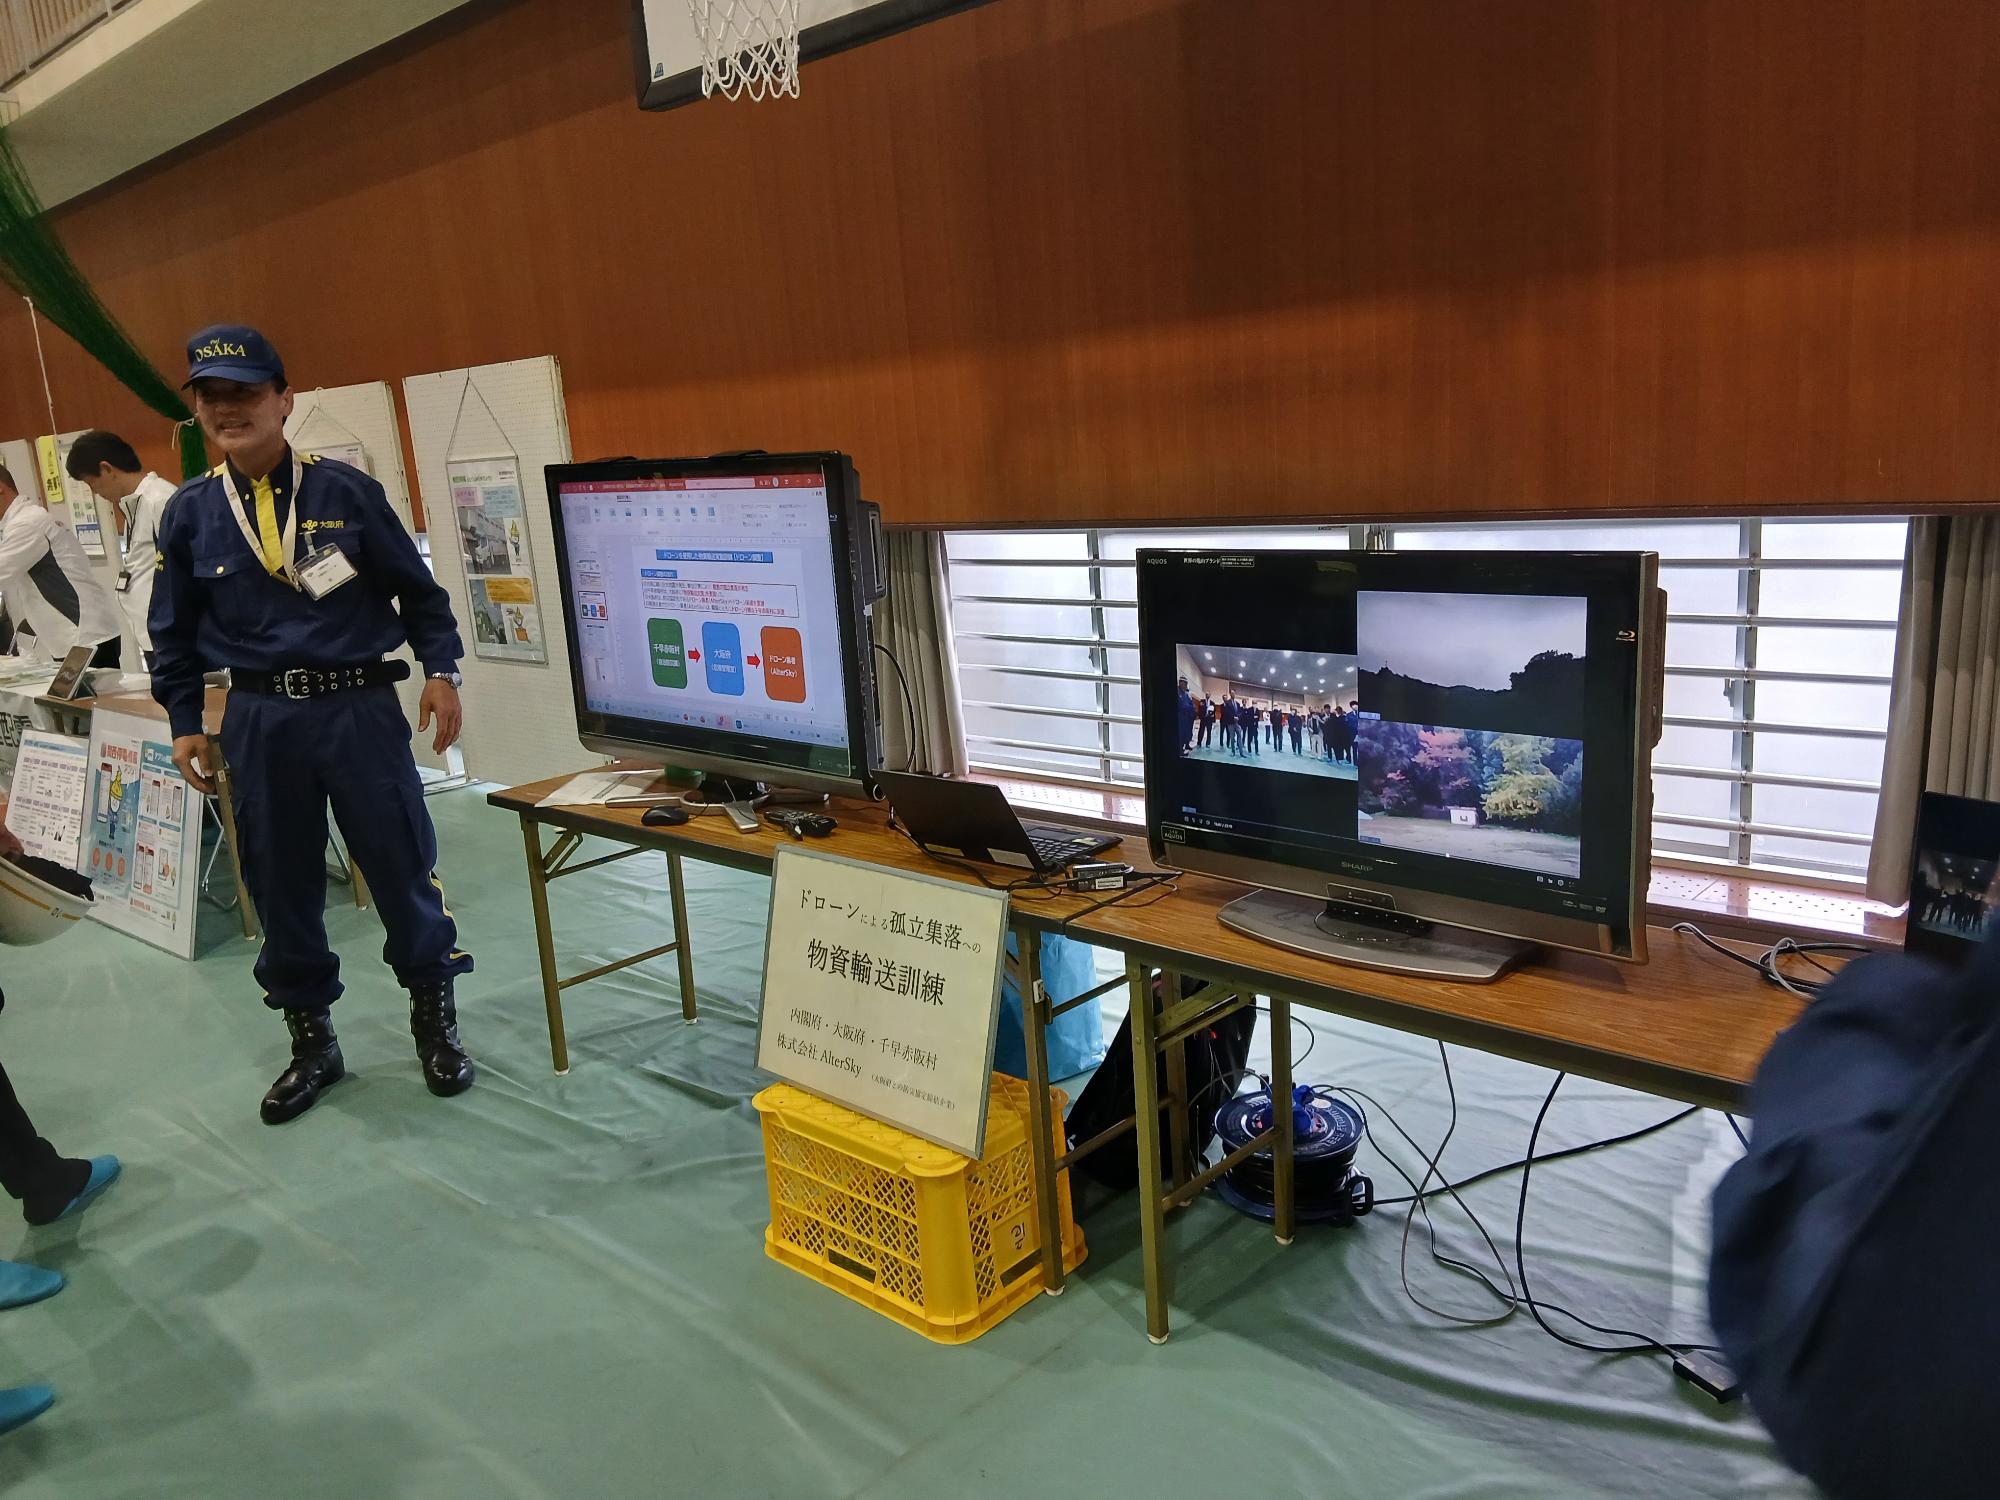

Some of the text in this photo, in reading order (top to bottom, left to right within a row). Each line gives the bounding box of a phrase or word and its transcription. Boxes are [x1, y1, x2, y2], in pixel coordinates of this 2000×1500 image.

[195, 343, 246, 362] OSAKA
[320, 520, 344, 529] 大阪府
[1341, 861, 1374, 872] SHARP
[800, 888, 981, 954] ドローンによる孤立集落への
[807, 937, 946, 1007] 物資輸送訓練
[777, 1032, 862, 1078] 株式会社 AlterSky
[790, 1007, 938, 1071] 内閣府・大阪府・千早赤阪村
